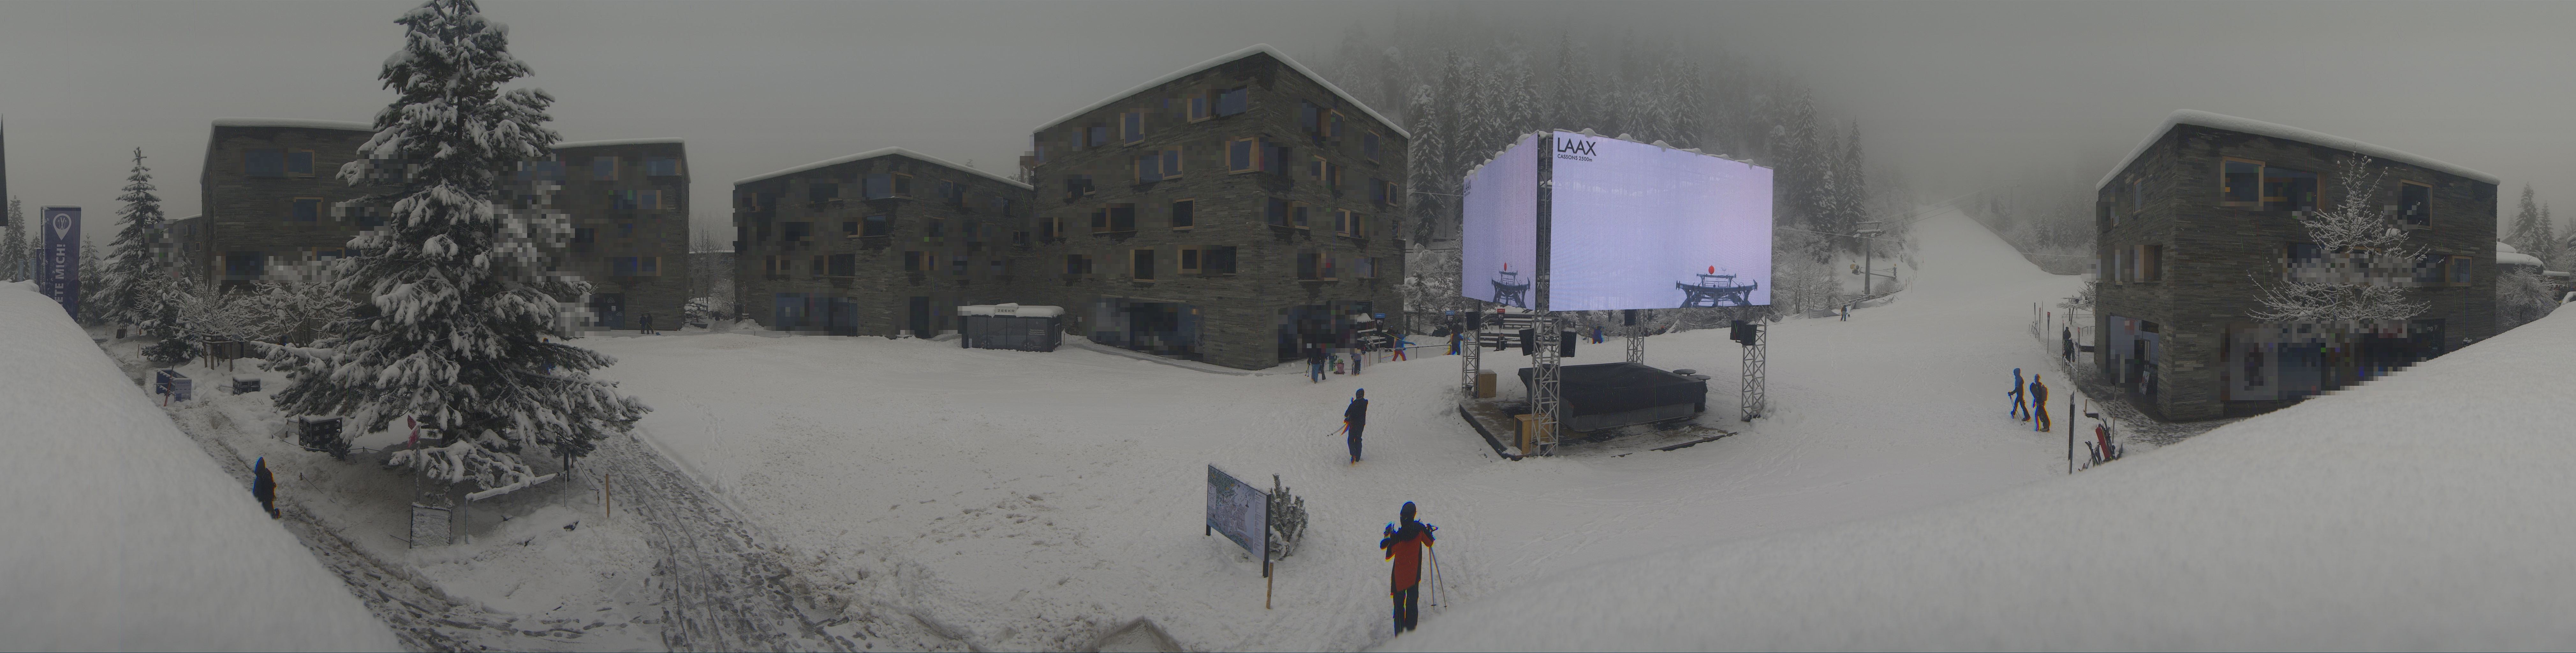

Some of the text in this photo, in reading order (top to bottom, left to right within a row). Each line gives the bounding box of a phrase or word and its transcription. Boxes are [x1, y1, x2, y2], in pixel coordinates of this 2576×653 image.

[1557, 137, 1596, 156] LAAX
[55, 244, 66, 306] ETE MICH!
